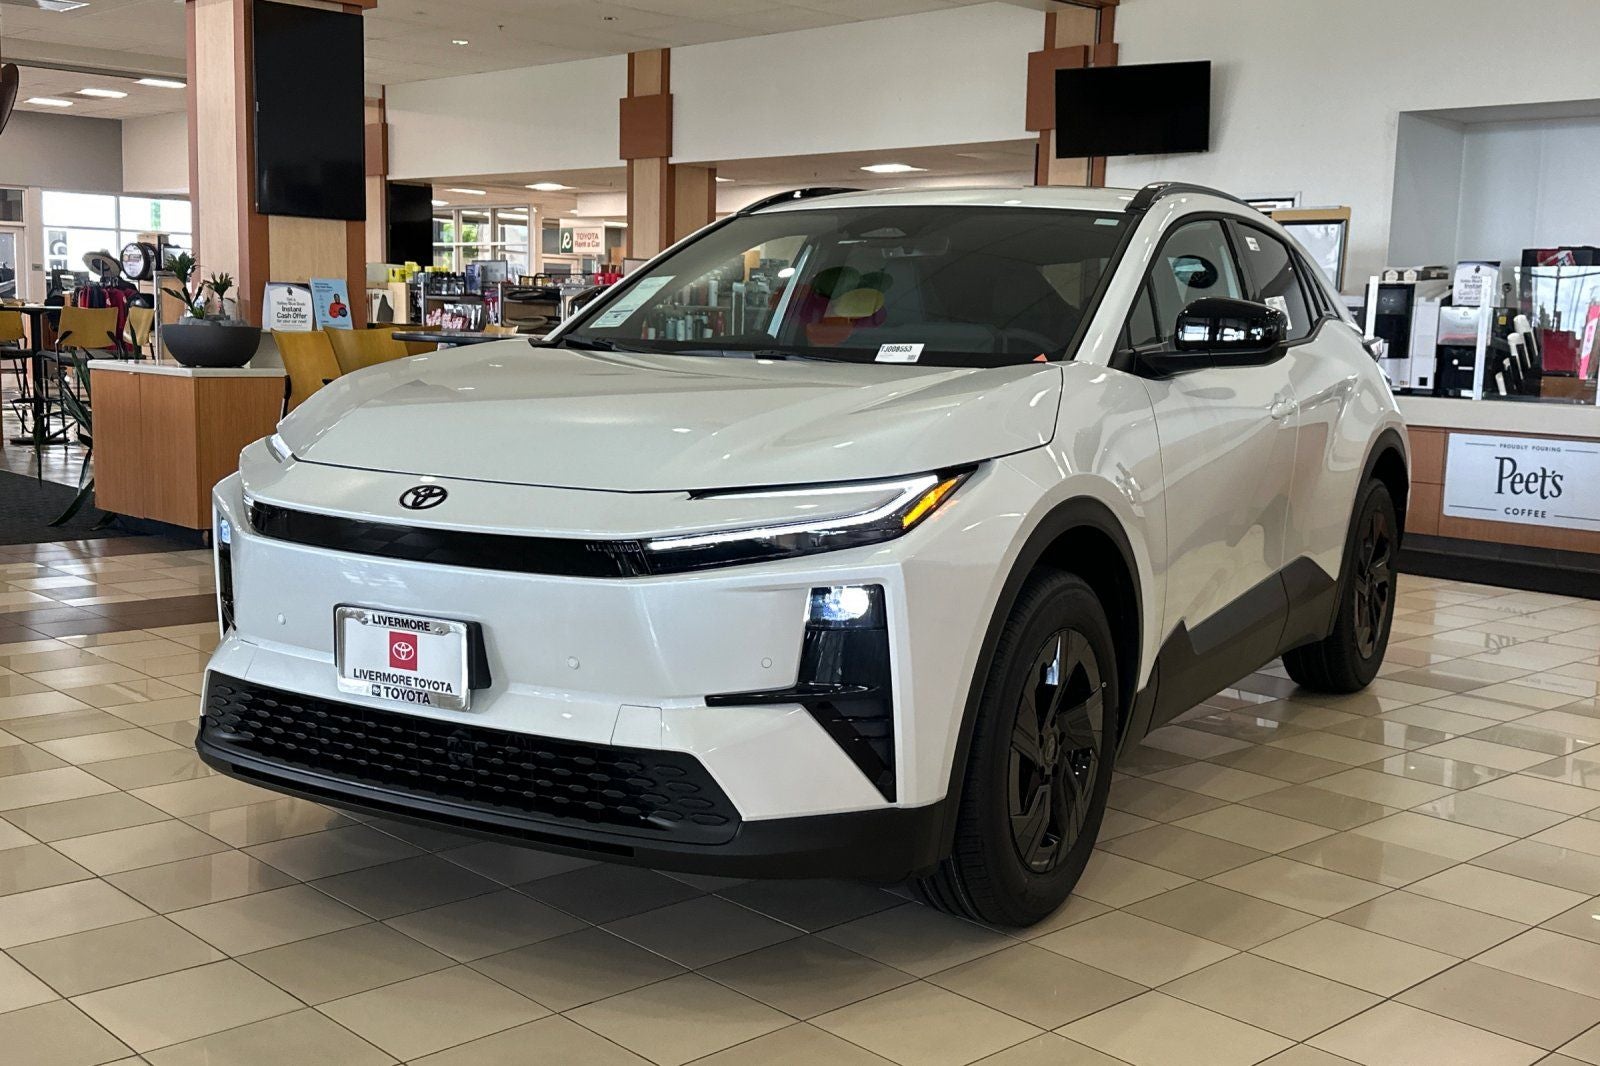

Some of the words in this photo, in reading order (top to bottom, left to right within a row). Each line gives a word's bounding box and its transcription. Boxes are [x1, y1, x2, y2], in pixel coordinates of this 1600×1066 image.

[576, 232, 599, 240] TOYOTA
[1494, 456, 1564, 500] Peet's
[1504, 507, 1547, 518] COFFEE
[372, 614, 431, 632] LIVERMORE
[353, 668, 412, 686] LIVERMORE
[413, 677, 453, 693] TOYOTA
[383, 686, 431, 705] TOYOTA
